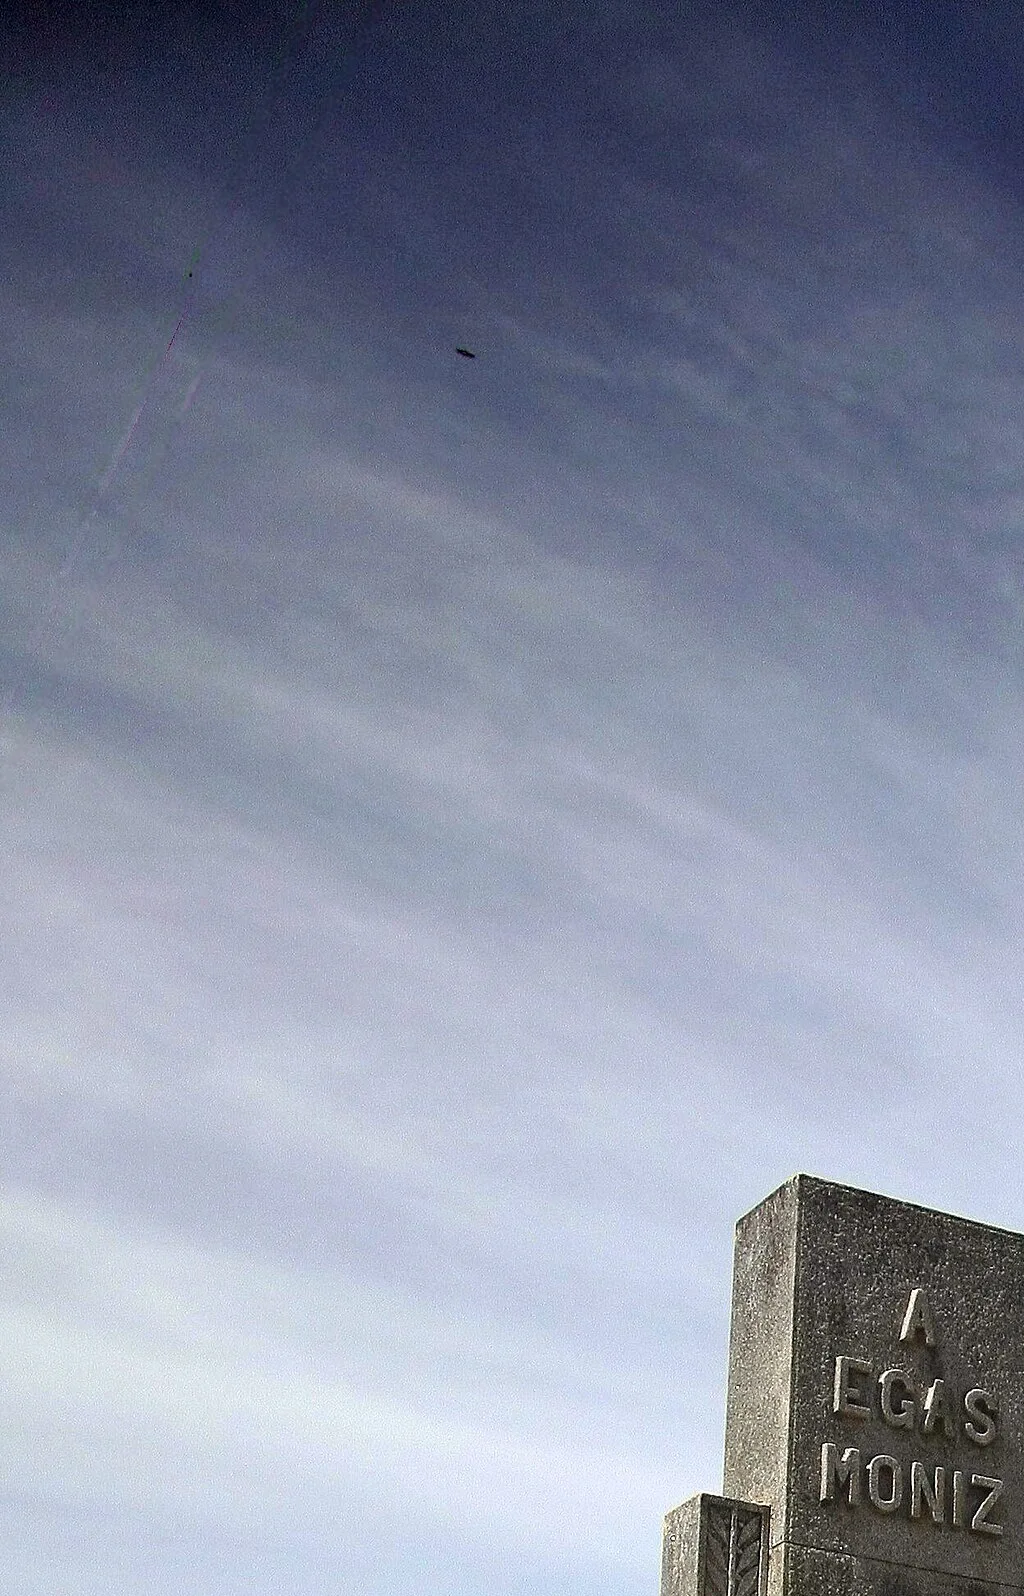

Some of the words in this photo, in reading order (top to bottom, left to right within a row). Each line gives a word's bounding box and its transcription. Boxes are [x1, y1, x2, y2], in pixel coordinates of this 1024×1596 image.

[900, 1287, 935, 1345] A
[833, 1355, 997, 1446] EGAS
[820, 1442, 1003, 1536] MONIZ
